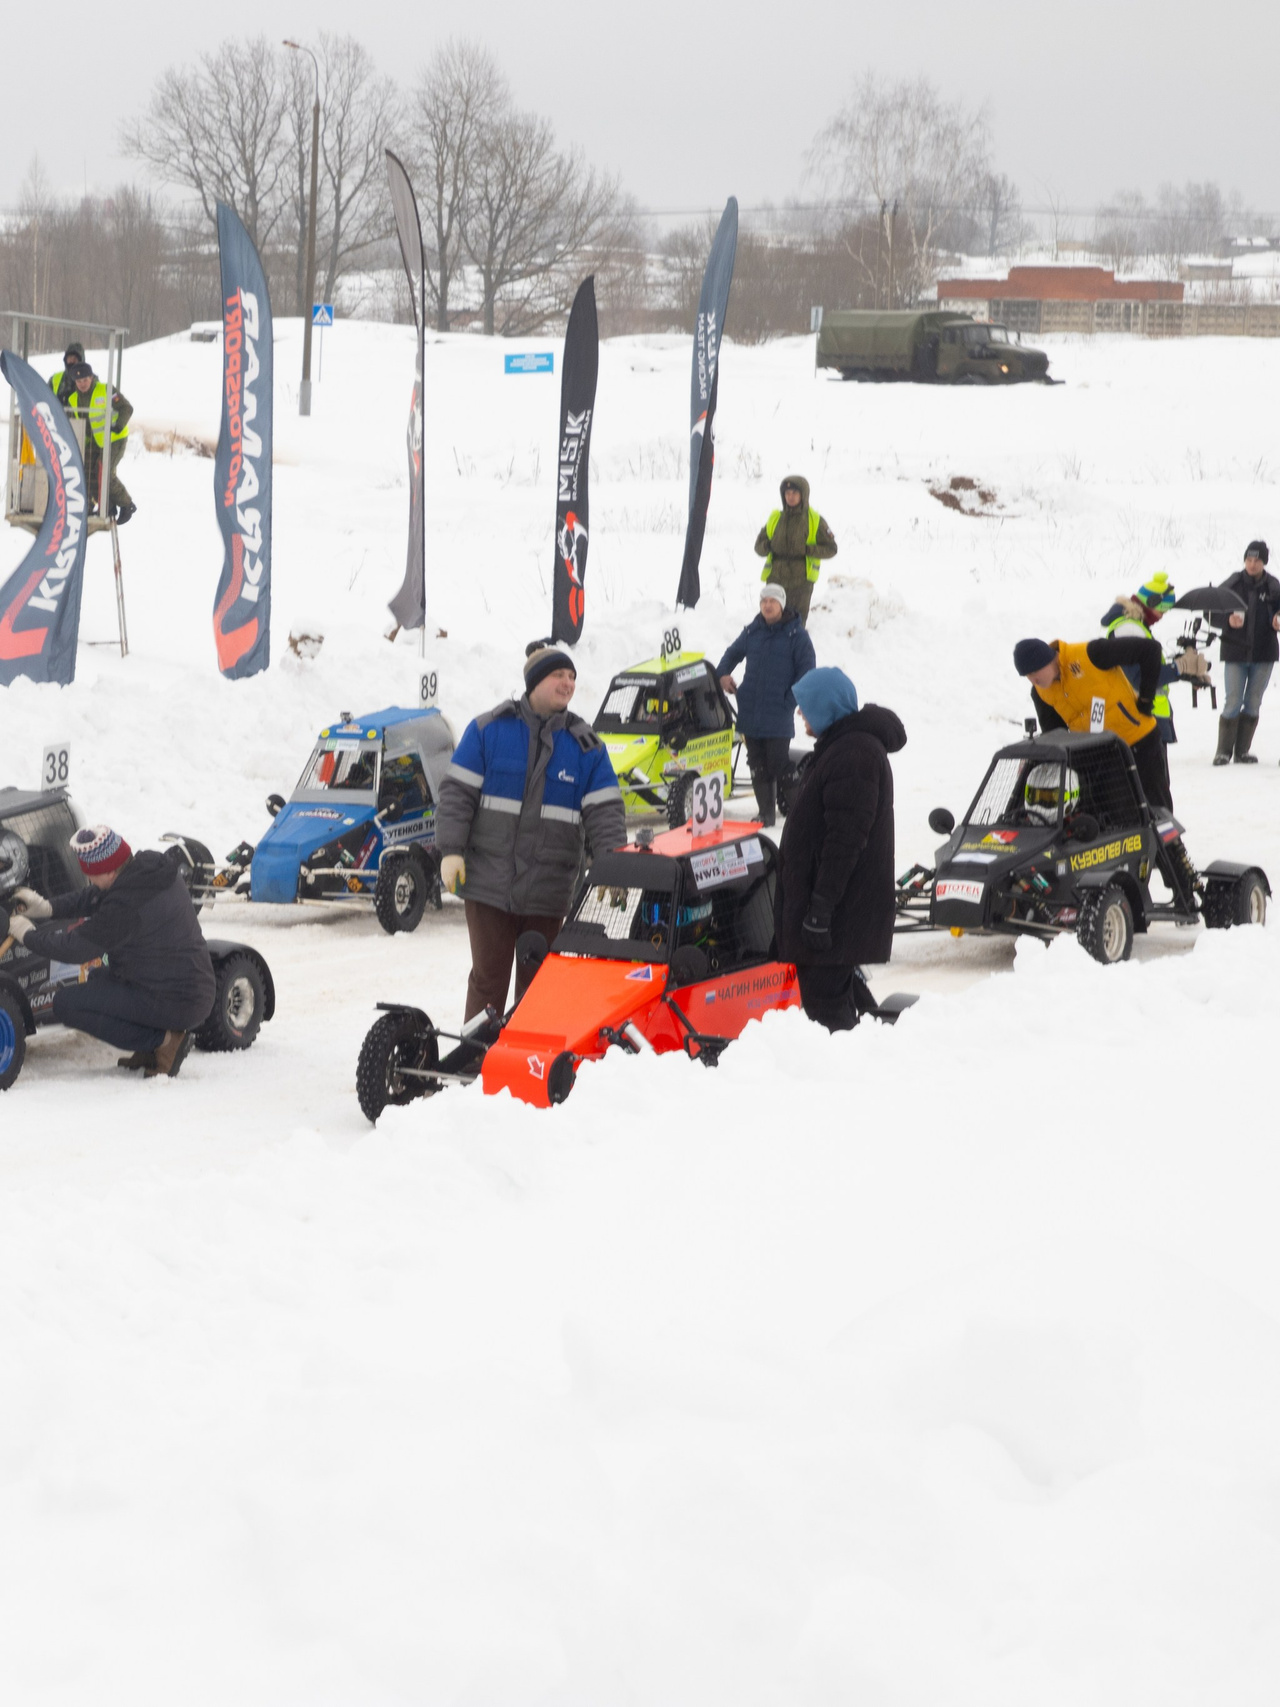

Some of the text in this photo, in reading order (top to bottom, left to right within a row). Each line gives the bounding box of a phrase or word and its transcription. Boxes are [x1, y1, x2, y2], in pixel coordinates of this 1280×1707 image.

[558, 409, 586, 501] MSK
[664, 627, 681, 654] 88
[421, 672, 437, 700] 89
[1091, 702, 1105, 723] 69
[46, 750, 68, 784] 38
[695, 777, 722, 824] 33
[1070, 834, 1142, 872] КУЗОВЛЕВ ЛЕВ
[718, 979, 750, 1001] ЧАГИН
